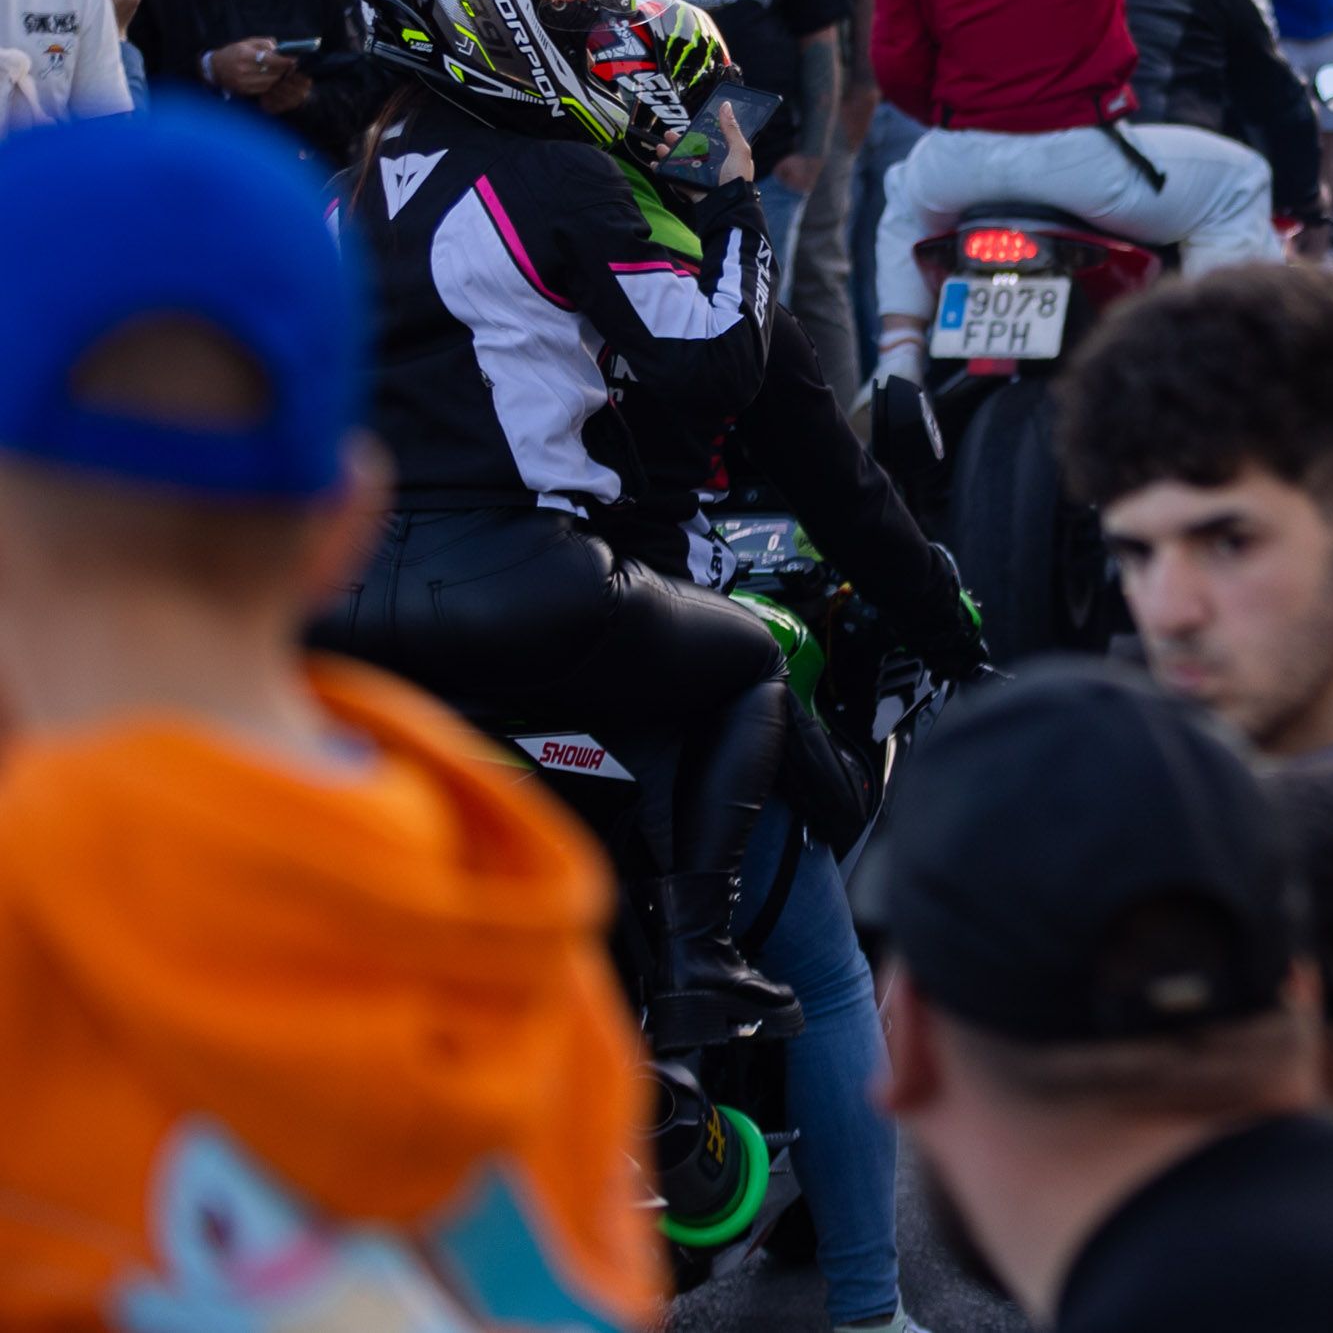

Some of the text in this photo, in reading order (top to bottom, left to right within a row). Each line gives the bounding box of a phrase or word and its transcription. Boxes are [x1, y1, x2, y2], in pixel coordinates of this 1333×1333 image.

[755, 233, 772, 329] DAINES
[970, 287, 1058, 319] 9078
[963, 320, 1031, 352] FPH
[540, 741, 606, 770] SHOWA
